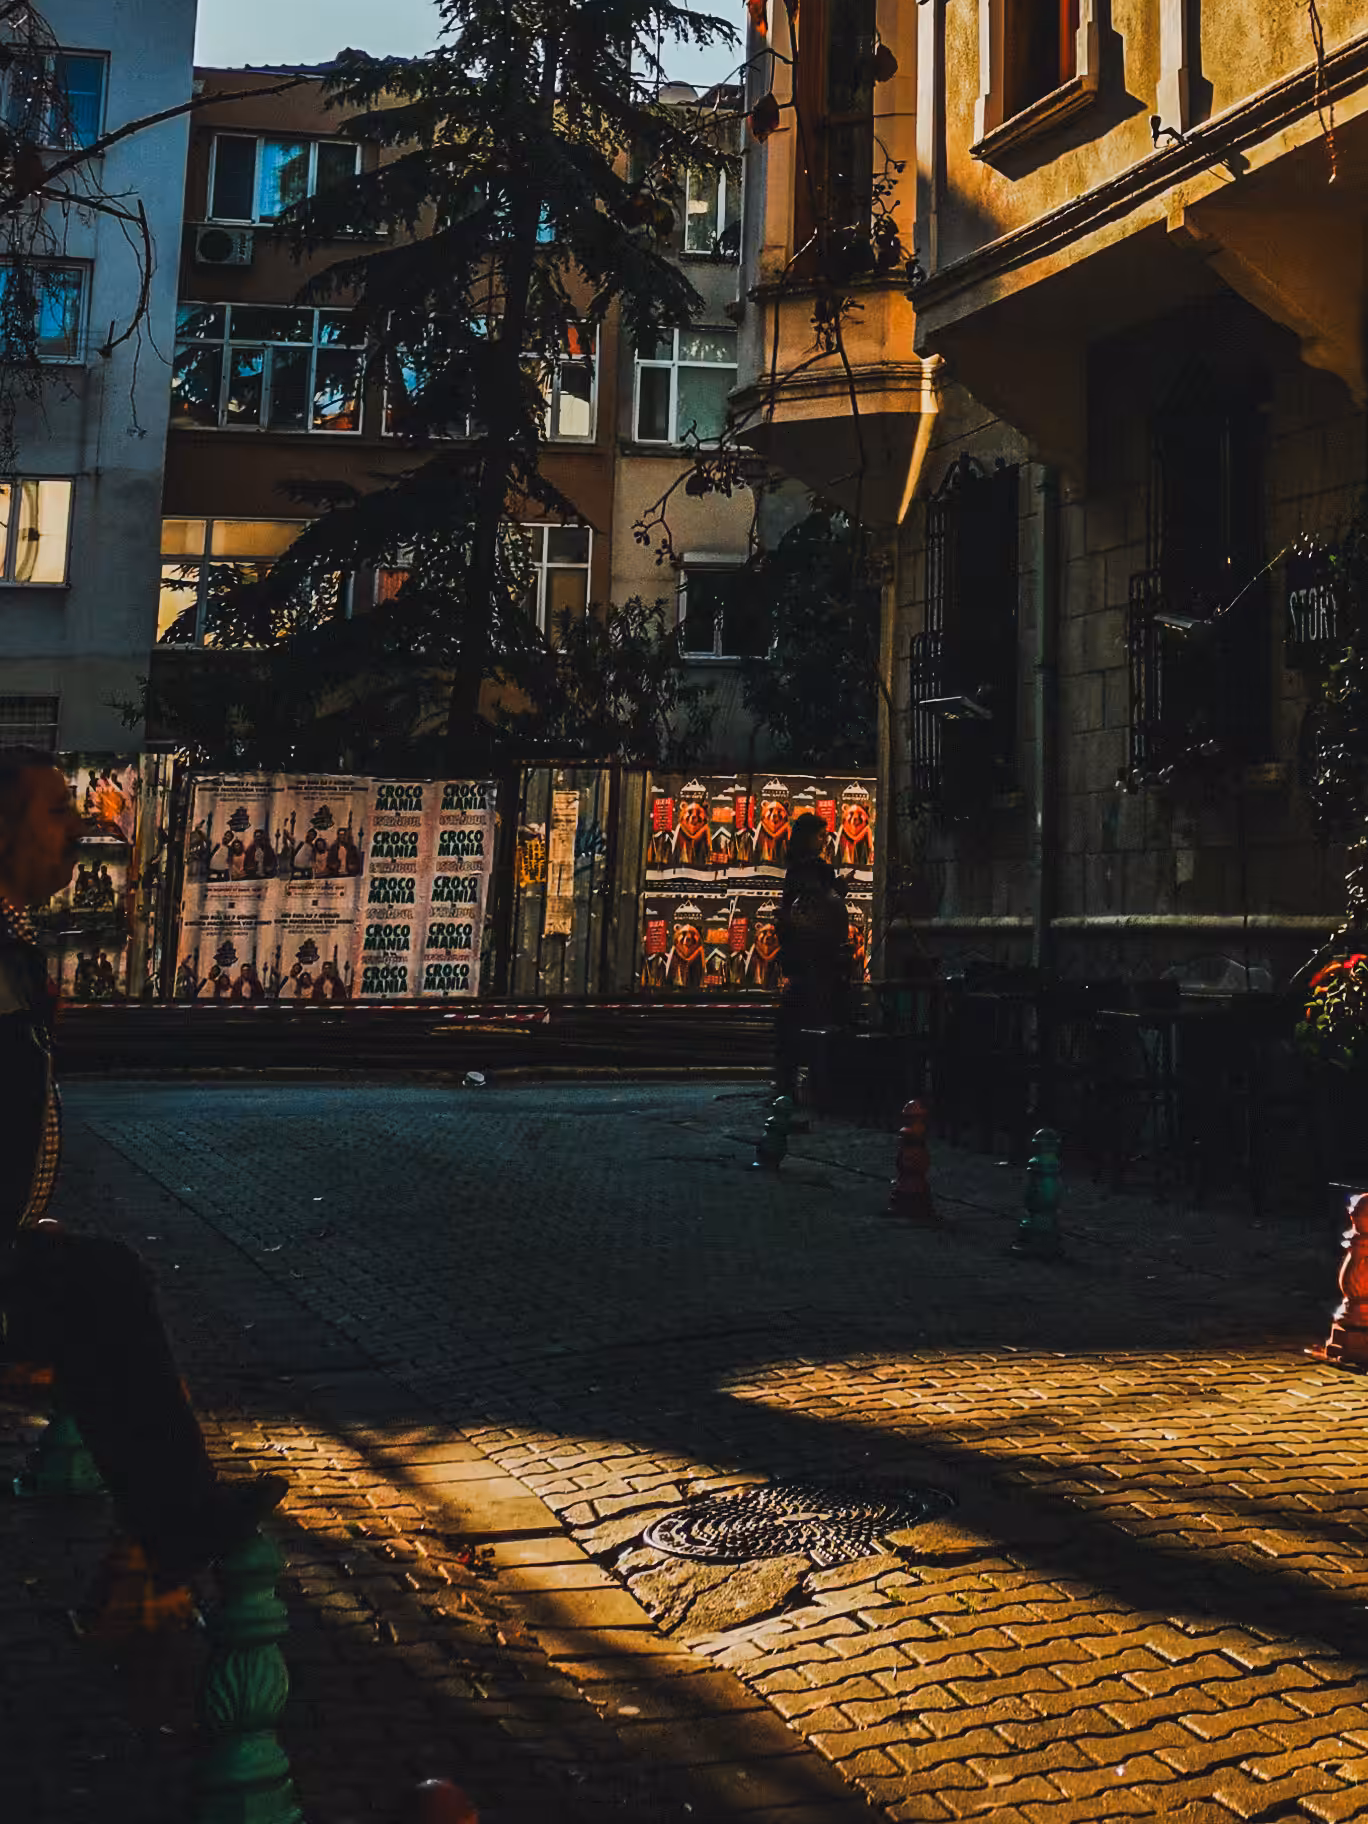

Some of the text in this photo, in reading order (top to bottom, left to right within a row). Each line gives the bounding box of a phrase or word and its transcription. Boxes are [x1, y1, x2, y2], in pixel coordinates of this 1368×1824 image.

[1289, 583, 1338, 644] STORY
[377, 784, 423, 798] CROCO
[443, 784, 485, 797] CROCO
[375, 797, 422, 811] MANIA
[441, 797, 487, 810] MANIA
[373, 831, 418, 845] CROCO
[440, 830, 484, 843] CROCO
[370, 844, 418, 858] MANIA
[438, 843, 484, 856] MANIA
[370, 877, 415, 890] CROCO
[433, 876, 478, 889] CROCO
[367, 889, 415, 904] MANIA
[431, 889, 478, 903] MANIA
[365, 924, 411, 937] CROCO
[429, 922, 473, 936] CROCO
[363, 937, 410, 951] MANIA
[426, 935, 472, 949] MANIA
[363, 965, 408, 979] CROCO
[426, 964, 470, 977] CROCO
[360, 979, 408, 993] MANIA
[423, 976, 469, 990] MANIA
